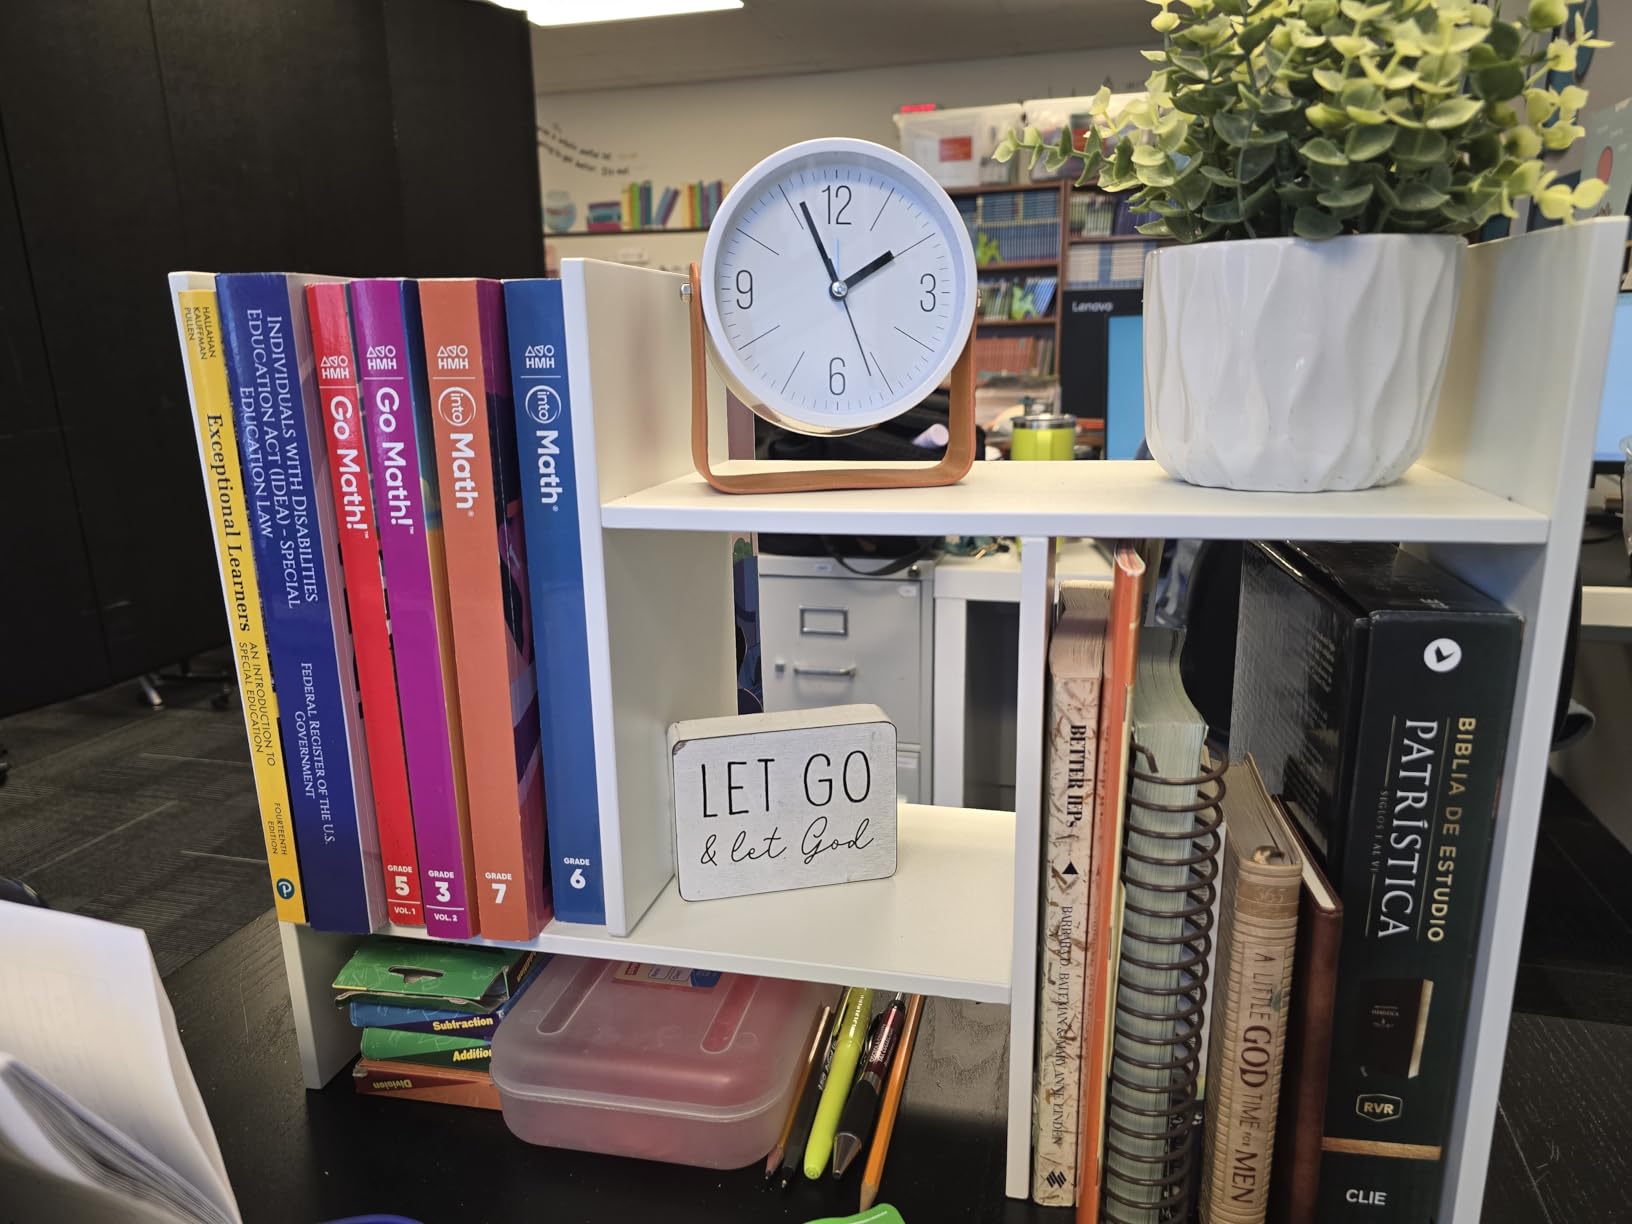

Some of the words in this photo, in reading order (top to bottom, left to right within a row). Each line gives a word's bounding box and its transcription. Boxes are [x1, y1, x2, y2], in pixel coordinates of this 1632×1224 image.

[821, 185, 853, 225] 12
[735, 269, 754, 310] 9
[919, 273, 937, 312] 3
[1072, 301, 1113, 313] Lenovo
[184, 306, 195, 341] PULLEN
[202, 306, 217, 358] HALLAHAN
[247, 309, 275, 422] EDUCATION
[266, 316, 297, 438] INDIVIDUALS
[322, 368, 350, 380] HMH
[367, 358, 397, 370] HMH
[438, 358, 469, 370] HMH
[525, 357, 555, 369] HMH
[828, 356, 846, 396] 6
[330, 395, 353, 440] Go
[376, 386, 400, 433] Go
[450, 392, 464, 424] into
[537, 391, 550, 421] into
[239, 386, 268, 496] EDUCATION
[256, 501, 273, 538] LAW
[264, 426, 282, 464] ACT
[285, 442, 303, 490] WITH
[269, 468, 291, 525] (IDEA)
[207, 413, 241, 537] Exceptional
[227, 544, 250, 632] Learners
[292, 496, 318, 602] DISABILITIES
[280, 541, 301, 609] SPECIAL
[249, 641, 260, 660] AN
[239, 642, 252, 685] SPECIAL
[246, 689, 264, 753] EDUCATION
[252, 663, 273, 749] INTRODUCTION
[301, 662, 317, 717] FEDERAL
[266, 752, 276, 767] TO
[294, 711, 315, 799] GOVERNMENT
[309, 720, 325, 777] REGISTER
[1067, 724, 1087, 789] BETTER
[1448, 717, 1476, 796] BIBLIA
[317, 779, 328, 796] OF
[701, 758, 775, 818] LET
[803, 750, 871, 807] GO
[319, 797, 331, 821] THE
[1442, 807, 1463, 836] DE
[267, 820, 278, 855] EDITION
[274, 802, 288, 856] FOURTEENTH
[322, 824, 336, 845] U.S.
[700, 834, 718, 866] &
[730, 827, 787, 863] let
[800, 816, 874, 864] God
[1378, 719, 1438, 938] PATRÍSTICA
[387, 864, 413, 873] GRADE
[428, 870, 455, 879] GRADE
[484, 872, 512, 881] GRADE
[563, 857, 591, 866] GRADE
[569, 868, 586, 890] 6
[395, 876, 410, 896] 5
[435, 881, 451, 902] 3
[491, 883, 507, 904] 7
[1427, 846, 1457, 942] ESTUDIO
[394, 906, 411, 915] VOL.
[434, 912, 451, 921] VOL.
[452, 914, 458, 922] 2
[1254, 952, 1276, 963] A
[1249, 972, 1275, 1021] LITTLE
[432, 1017, 494, 1031] Subtraction
[1239, 1025, 1272, 1088] GOD
[372, 1079, 413, 1089] Division
[1239, 1093, 1263, 1130] TIME
[1363, 1102, 1395, 1115] RVR
[1231, 1149, 1259, 1204] MEN
[1345, 1189, 1388, 1206] CLIE
